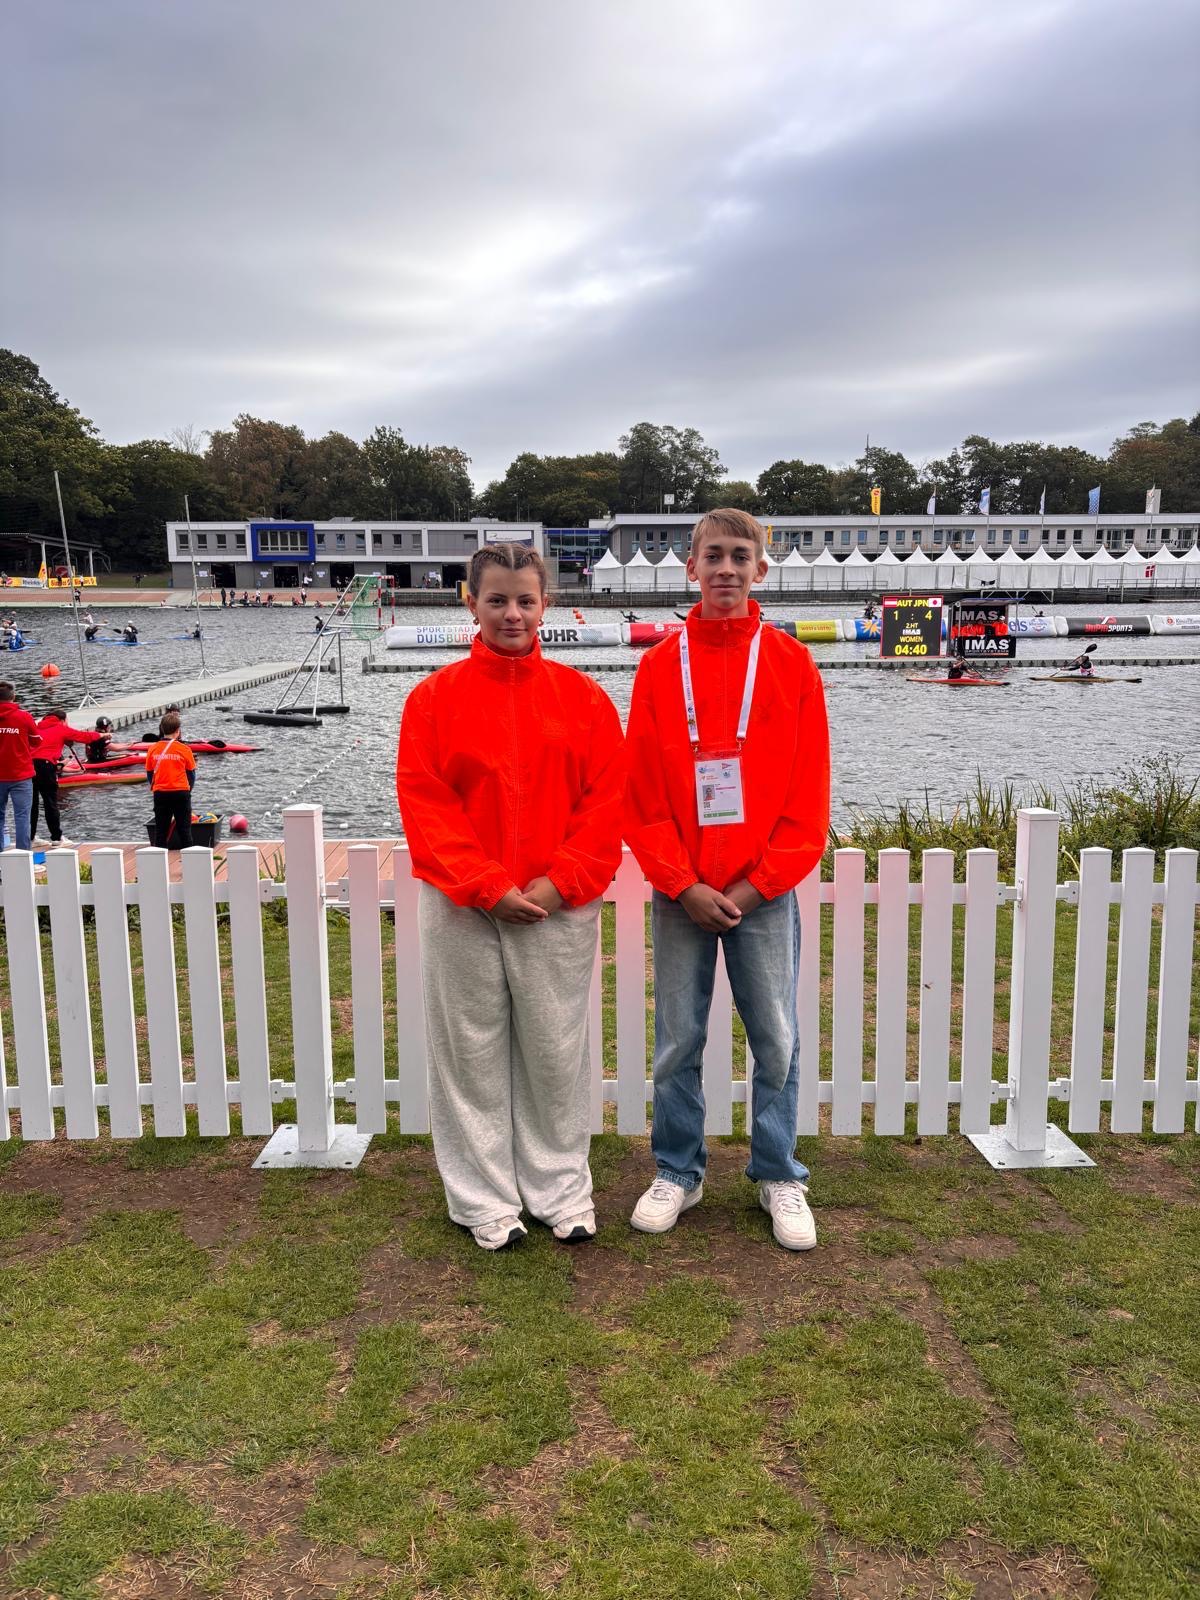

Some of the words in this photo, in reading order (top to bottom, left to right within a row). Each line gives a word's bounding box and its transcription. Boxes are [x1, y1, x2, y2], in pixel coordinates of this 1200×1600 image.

[897, 599, 912, 607] AUT
[914, 599, 929, 607] JPN
[893, 610, 899, 621] 1
[924, 610, 932, 621] 4
[417, 634, 475, 643] DUISBURG
[538, 629, 579, 642] UHR
[894, 644, 927, 655] 04:40
[965, 639, 1009, 650] IMAS
